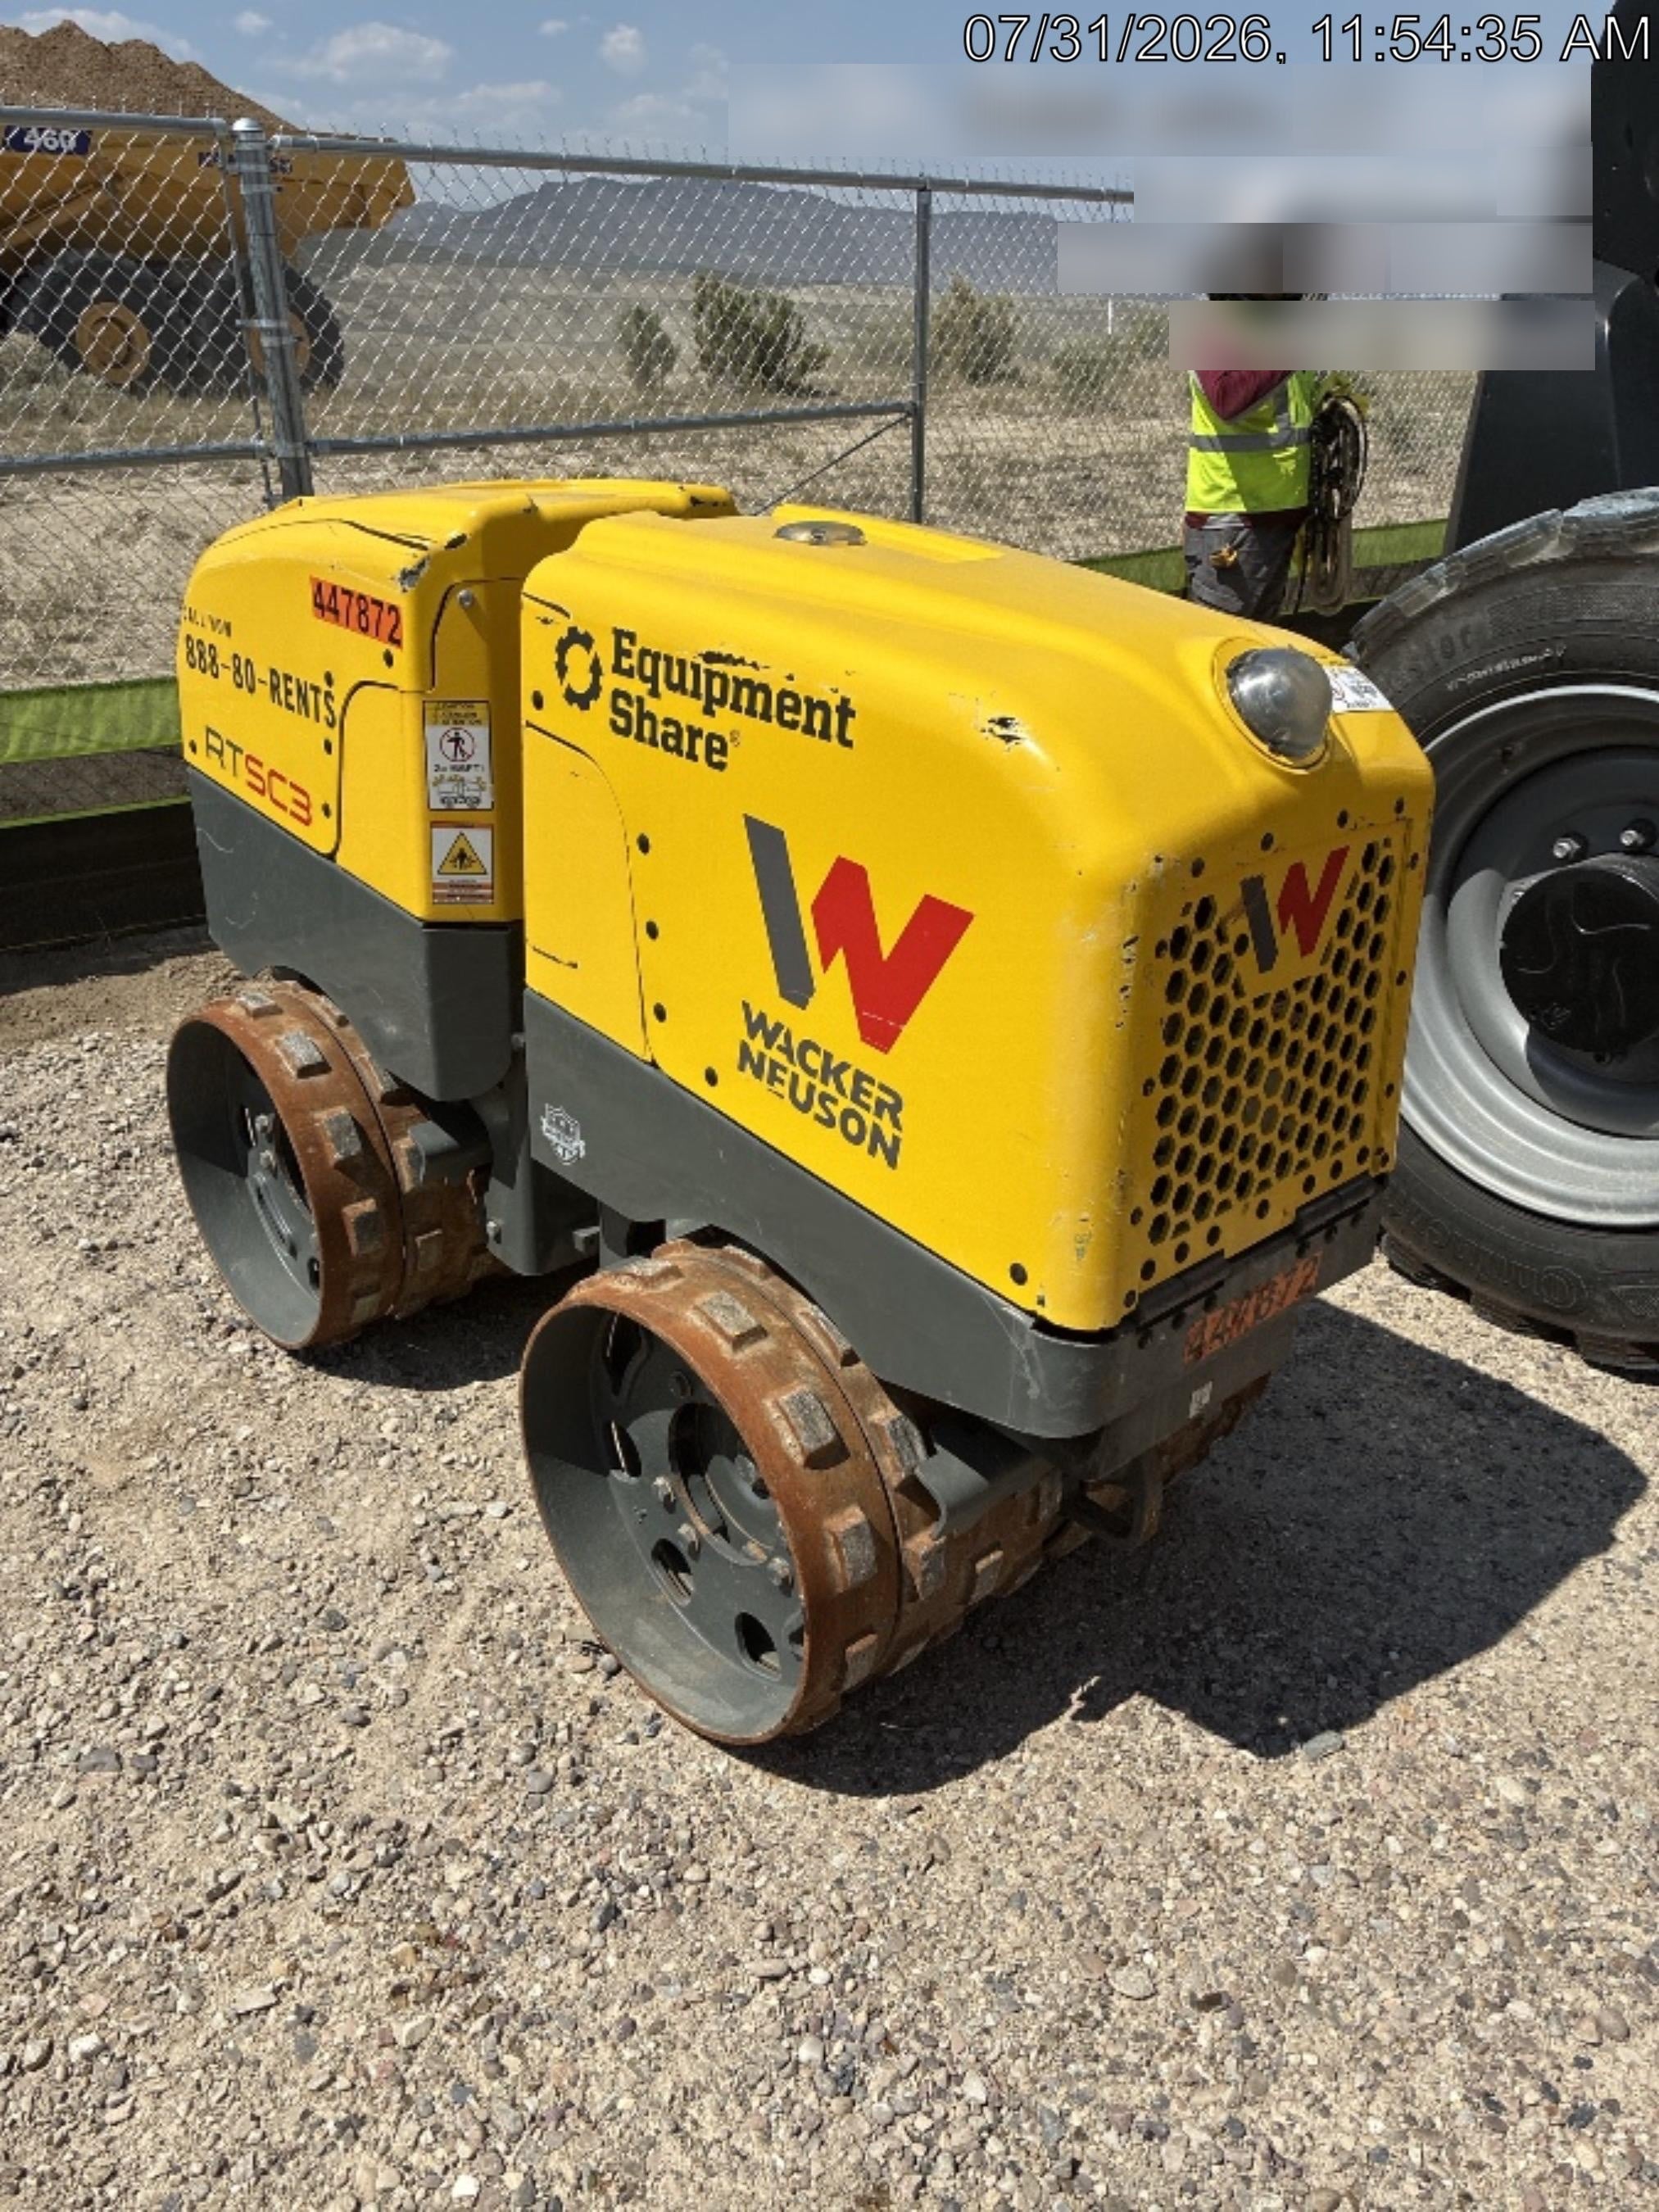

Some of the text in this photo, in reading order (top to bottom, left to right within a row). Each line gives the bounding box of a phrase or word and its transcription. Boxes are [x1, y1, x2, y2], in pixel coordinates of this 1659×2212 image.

[313, 580, 402, 647] 447872
[185, 633, 336, 729] 888-80-RENTS
[611, 626, 856, 750] Equipment
[737, 1039, 902, 1171] NEUSON
[741, 999, 904, 1131] WACKER
